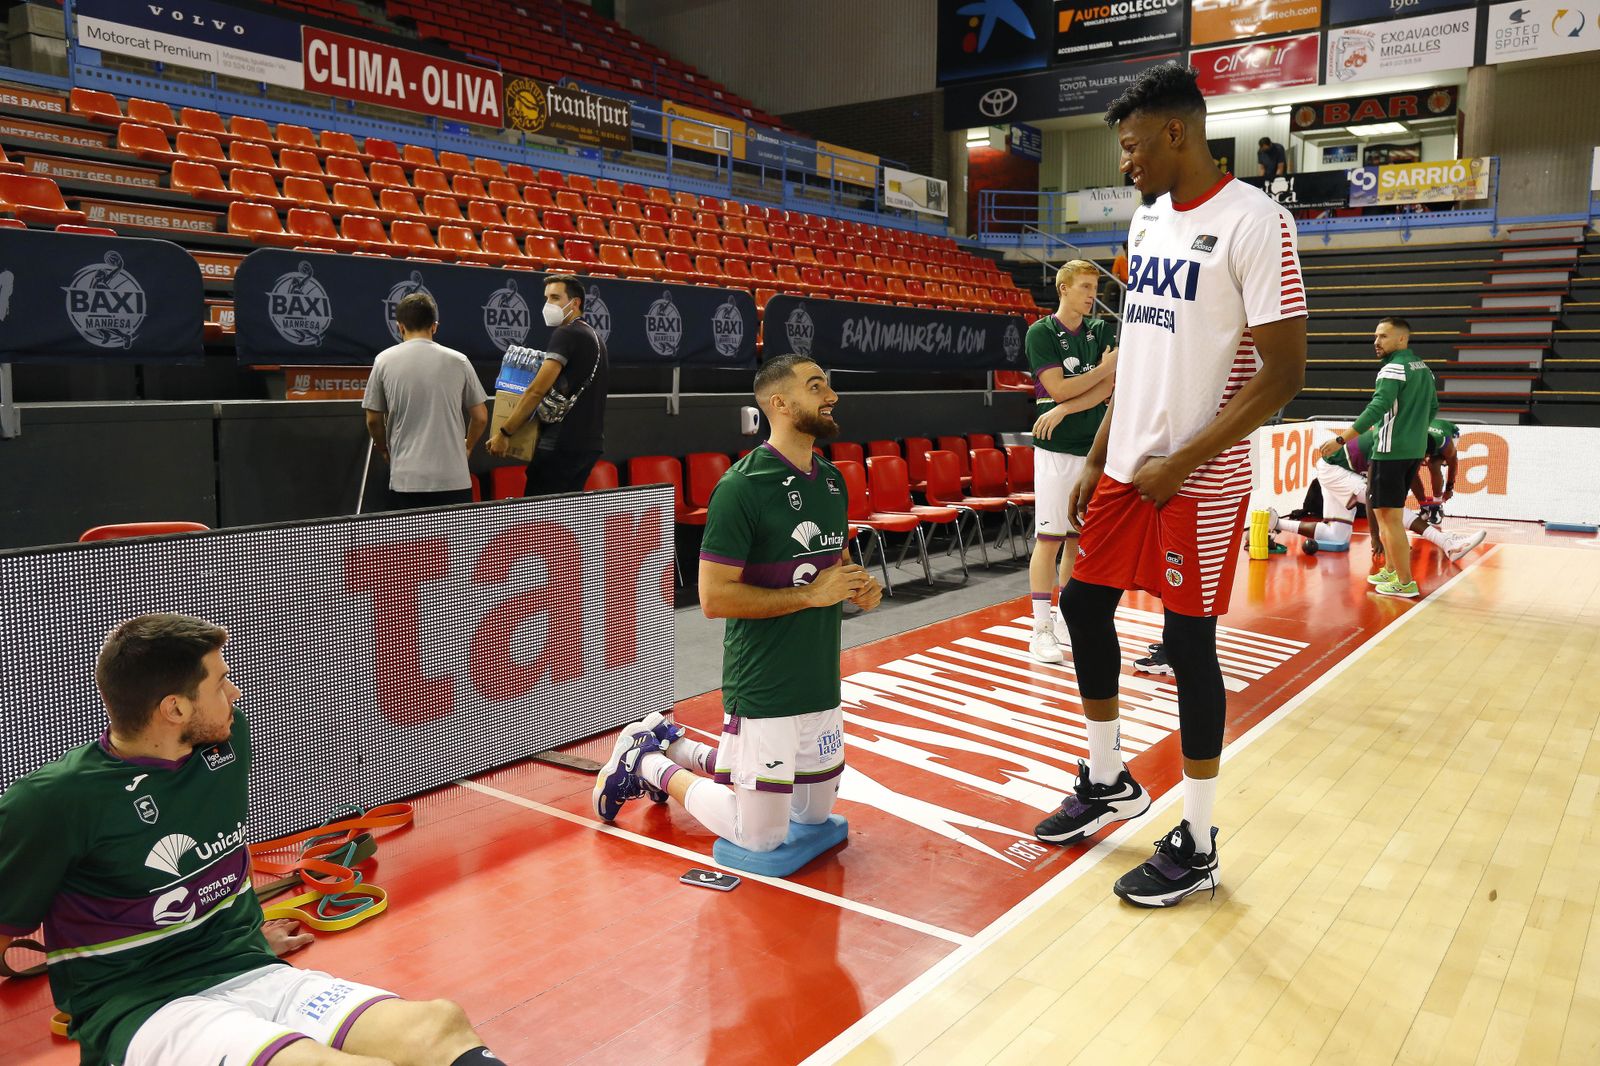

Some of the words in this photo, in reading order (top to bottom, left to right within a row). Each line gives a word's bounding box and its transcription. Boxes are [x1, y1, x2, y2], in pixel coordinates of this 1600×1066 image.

[148, 5, 245, 35] VOLVO
[1381, 21, 1470, 44] EXCAVACIONS
[1495, 24, 1540, 39] OSTEO
[87, 25, 151, 50] Motorcat
[154, 39, 212, 63] Premium
[1380, 39, 1441, 57] MIRALLES
[1495, 35, 1539, 50] SPORT
[1059, 79, 1087, 91] TOYOTA
[1088, 76, 1117, 87] TALLERS
[22, 98, 62, 112] BAGES
[546, 85, 629, 127] frankfurt
[1322, 95, 1418, 124] BAR
[0, 126, 61, 142] NETEGES
[62, 135, 103, 148] BAGES
[33, 160, 49, 173] NB
[52, 166, 112, 182] NETEGES
[115, 175, 156, 187] BAGES
[1381, 159, 1467, 189] SARRIÓ
[89, 206, 105, 219] NB
[109, 211, 169, 228] NETEGES
[172, 218, 214, 231] BAGES
[1127, 255, 1201, 301] BAXI
[70, 290, 144, 315] BAXI
[272, 294, 330, 318] BAXI
[85, 318, 131, 329] MANRESA
[220, 310, 236, 322] NB
[282, 318, 321, 331] MANRESA
[486, 309, 529, 328] BAXI
[584, 313, 609, 331] AXI
[647, 316, 681, 333] BAXI
[1126, 303, 1176, 334] MANRESA
[714, 319, 742, 335] BAXI
[788, 323, 814, 339] BAXI
[840, 315, 986, 355] BAXIMANRESA.COM
[294, 374, 311, 387] NB
[314, 378, 367, 391] NETEGE
[344, 505, 675, 727] tar
[207, 752, 220, 762] liga
[210, 753, 234, 767] endesa
[1003, 840, 1049, 863] 1876
[198, 880, 220, 897] COSTA
[221, 873, 238, 886] DEL
[200, 886, 231, 906] MÁLAGA
